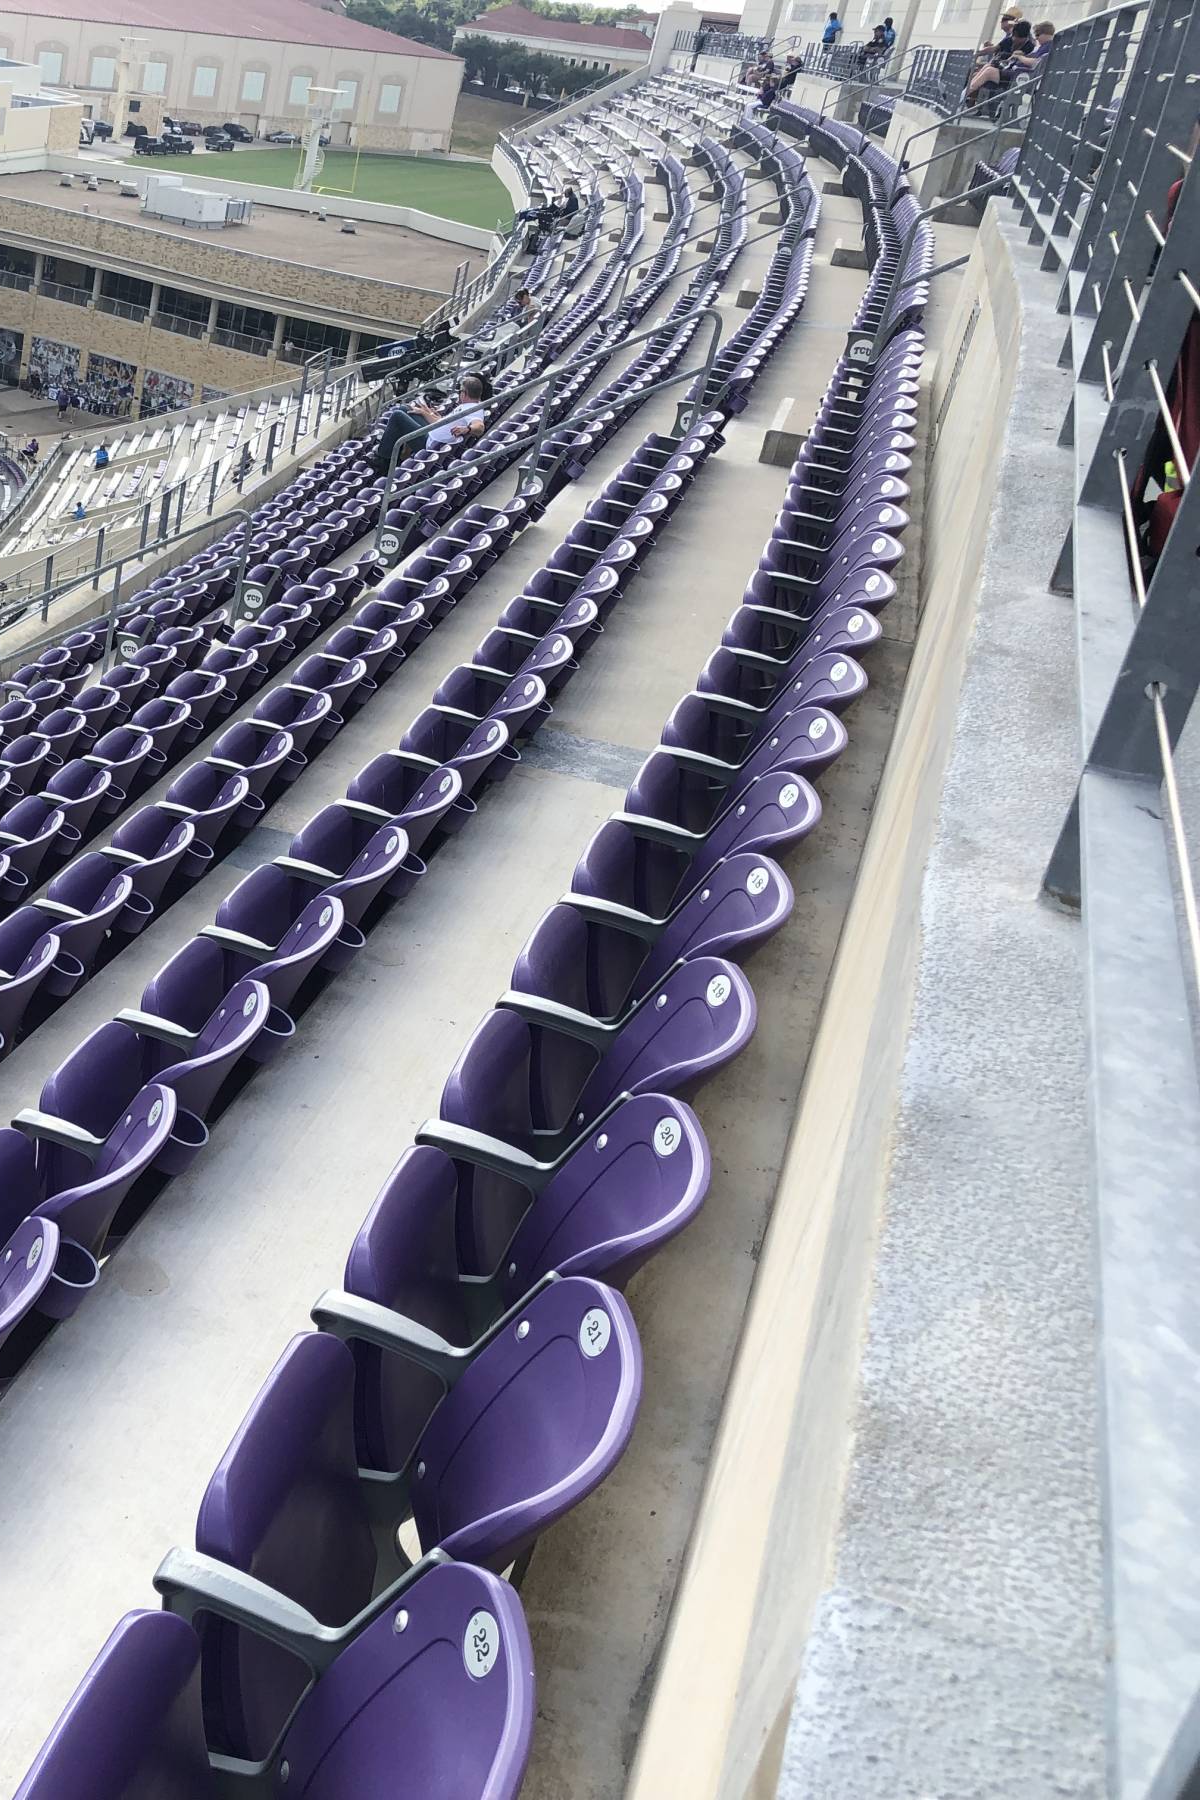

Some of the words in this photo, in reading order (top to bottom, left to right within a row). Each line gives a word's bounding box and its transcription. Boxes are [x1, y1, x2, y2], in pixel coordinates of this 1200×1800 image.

[853, 346, 871, 357] TCU
[381, 539, 397, 548] TCU
[246, 594, 261, 603] TCU
[122, 645, 137, 654] TCU
[783, 790, 795, 802] 17
[751, 875, 764, 889] 18
[712, 982, 725, 998] 19
[660, 1126, 675, 1147] 20
[586, 1320, 602, 1344] 21
[472, 1627, 490, 1663] 22
